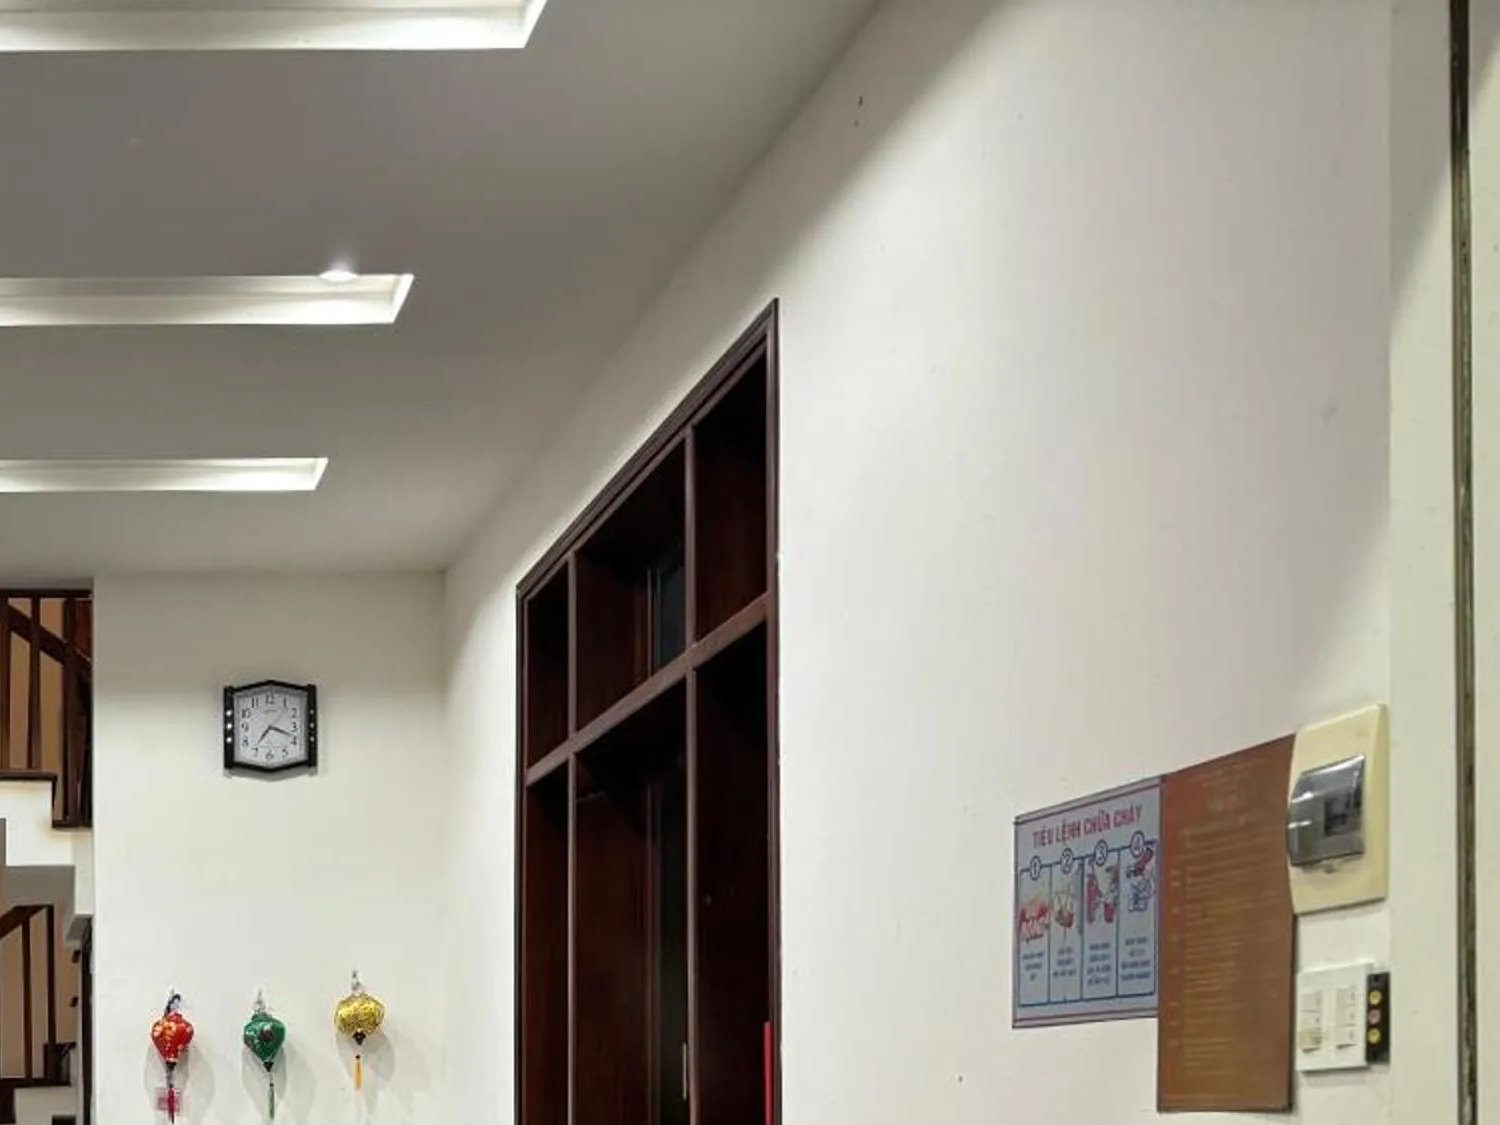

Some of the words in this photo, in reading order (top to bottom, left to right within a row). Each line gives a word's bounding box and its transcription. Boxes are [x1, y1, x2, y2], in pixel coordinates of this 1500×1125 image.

[251, 697, 259, 709] 11
[265, 694, 275, 705] 12
[282, 696, 287, 708] 1
[241, 707, 251, 719] 10
[290, 706, 298, 719] 2
[241, 721, 250, 732] 9
[290, 721, 298, 733] 3
[241, 736, 249, 747] 8
[290, 735, 298, 747] 4
[251, 747, 259, 758] 7
[265, 749, 275, 760] 6
[281, 747, 289, 759] 5
